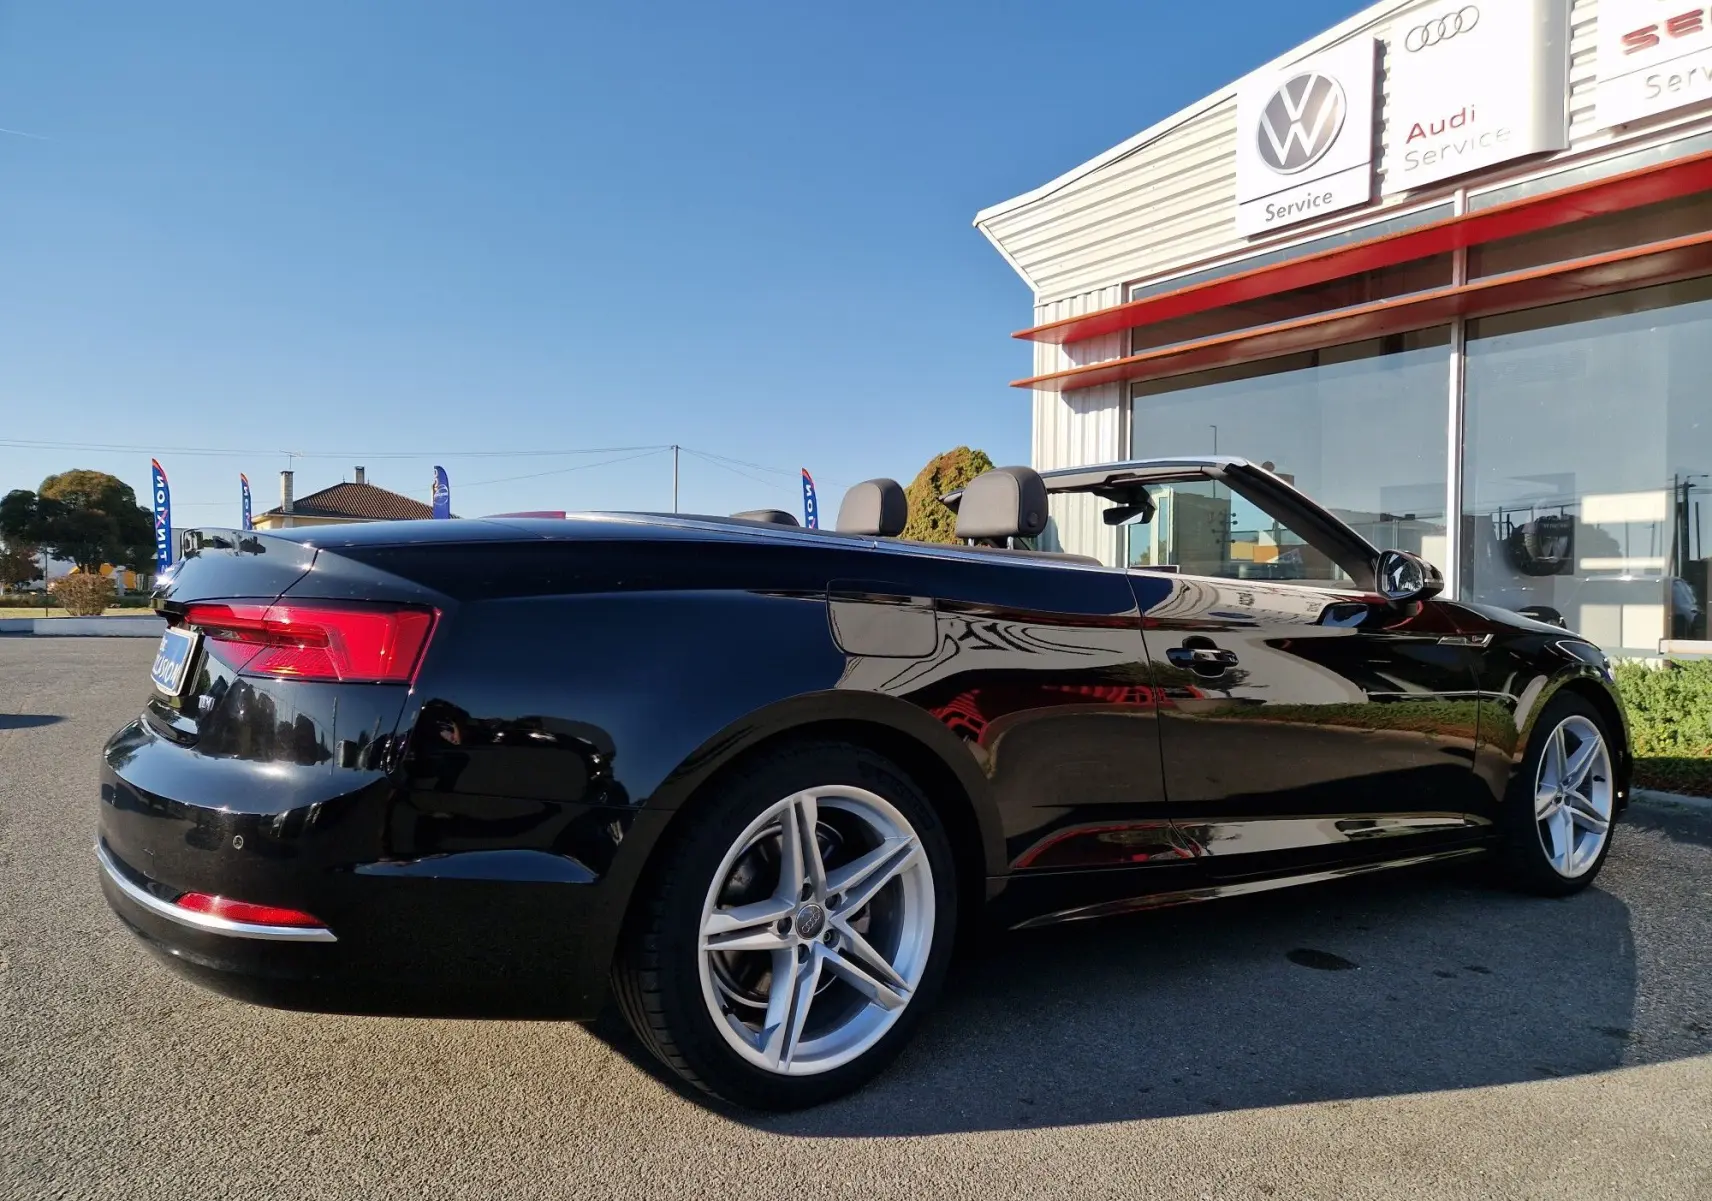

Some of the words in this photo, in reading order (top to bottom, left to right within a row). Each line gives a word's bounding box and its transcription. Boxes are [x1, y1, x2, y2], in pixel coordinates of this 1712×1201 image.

[1621, 6, 1712, 54] SE
[1405, 104, 1475, 144] Audi
[1403, 126, 1512, 171] Service
[1265, 192, 1333, 222] Service
